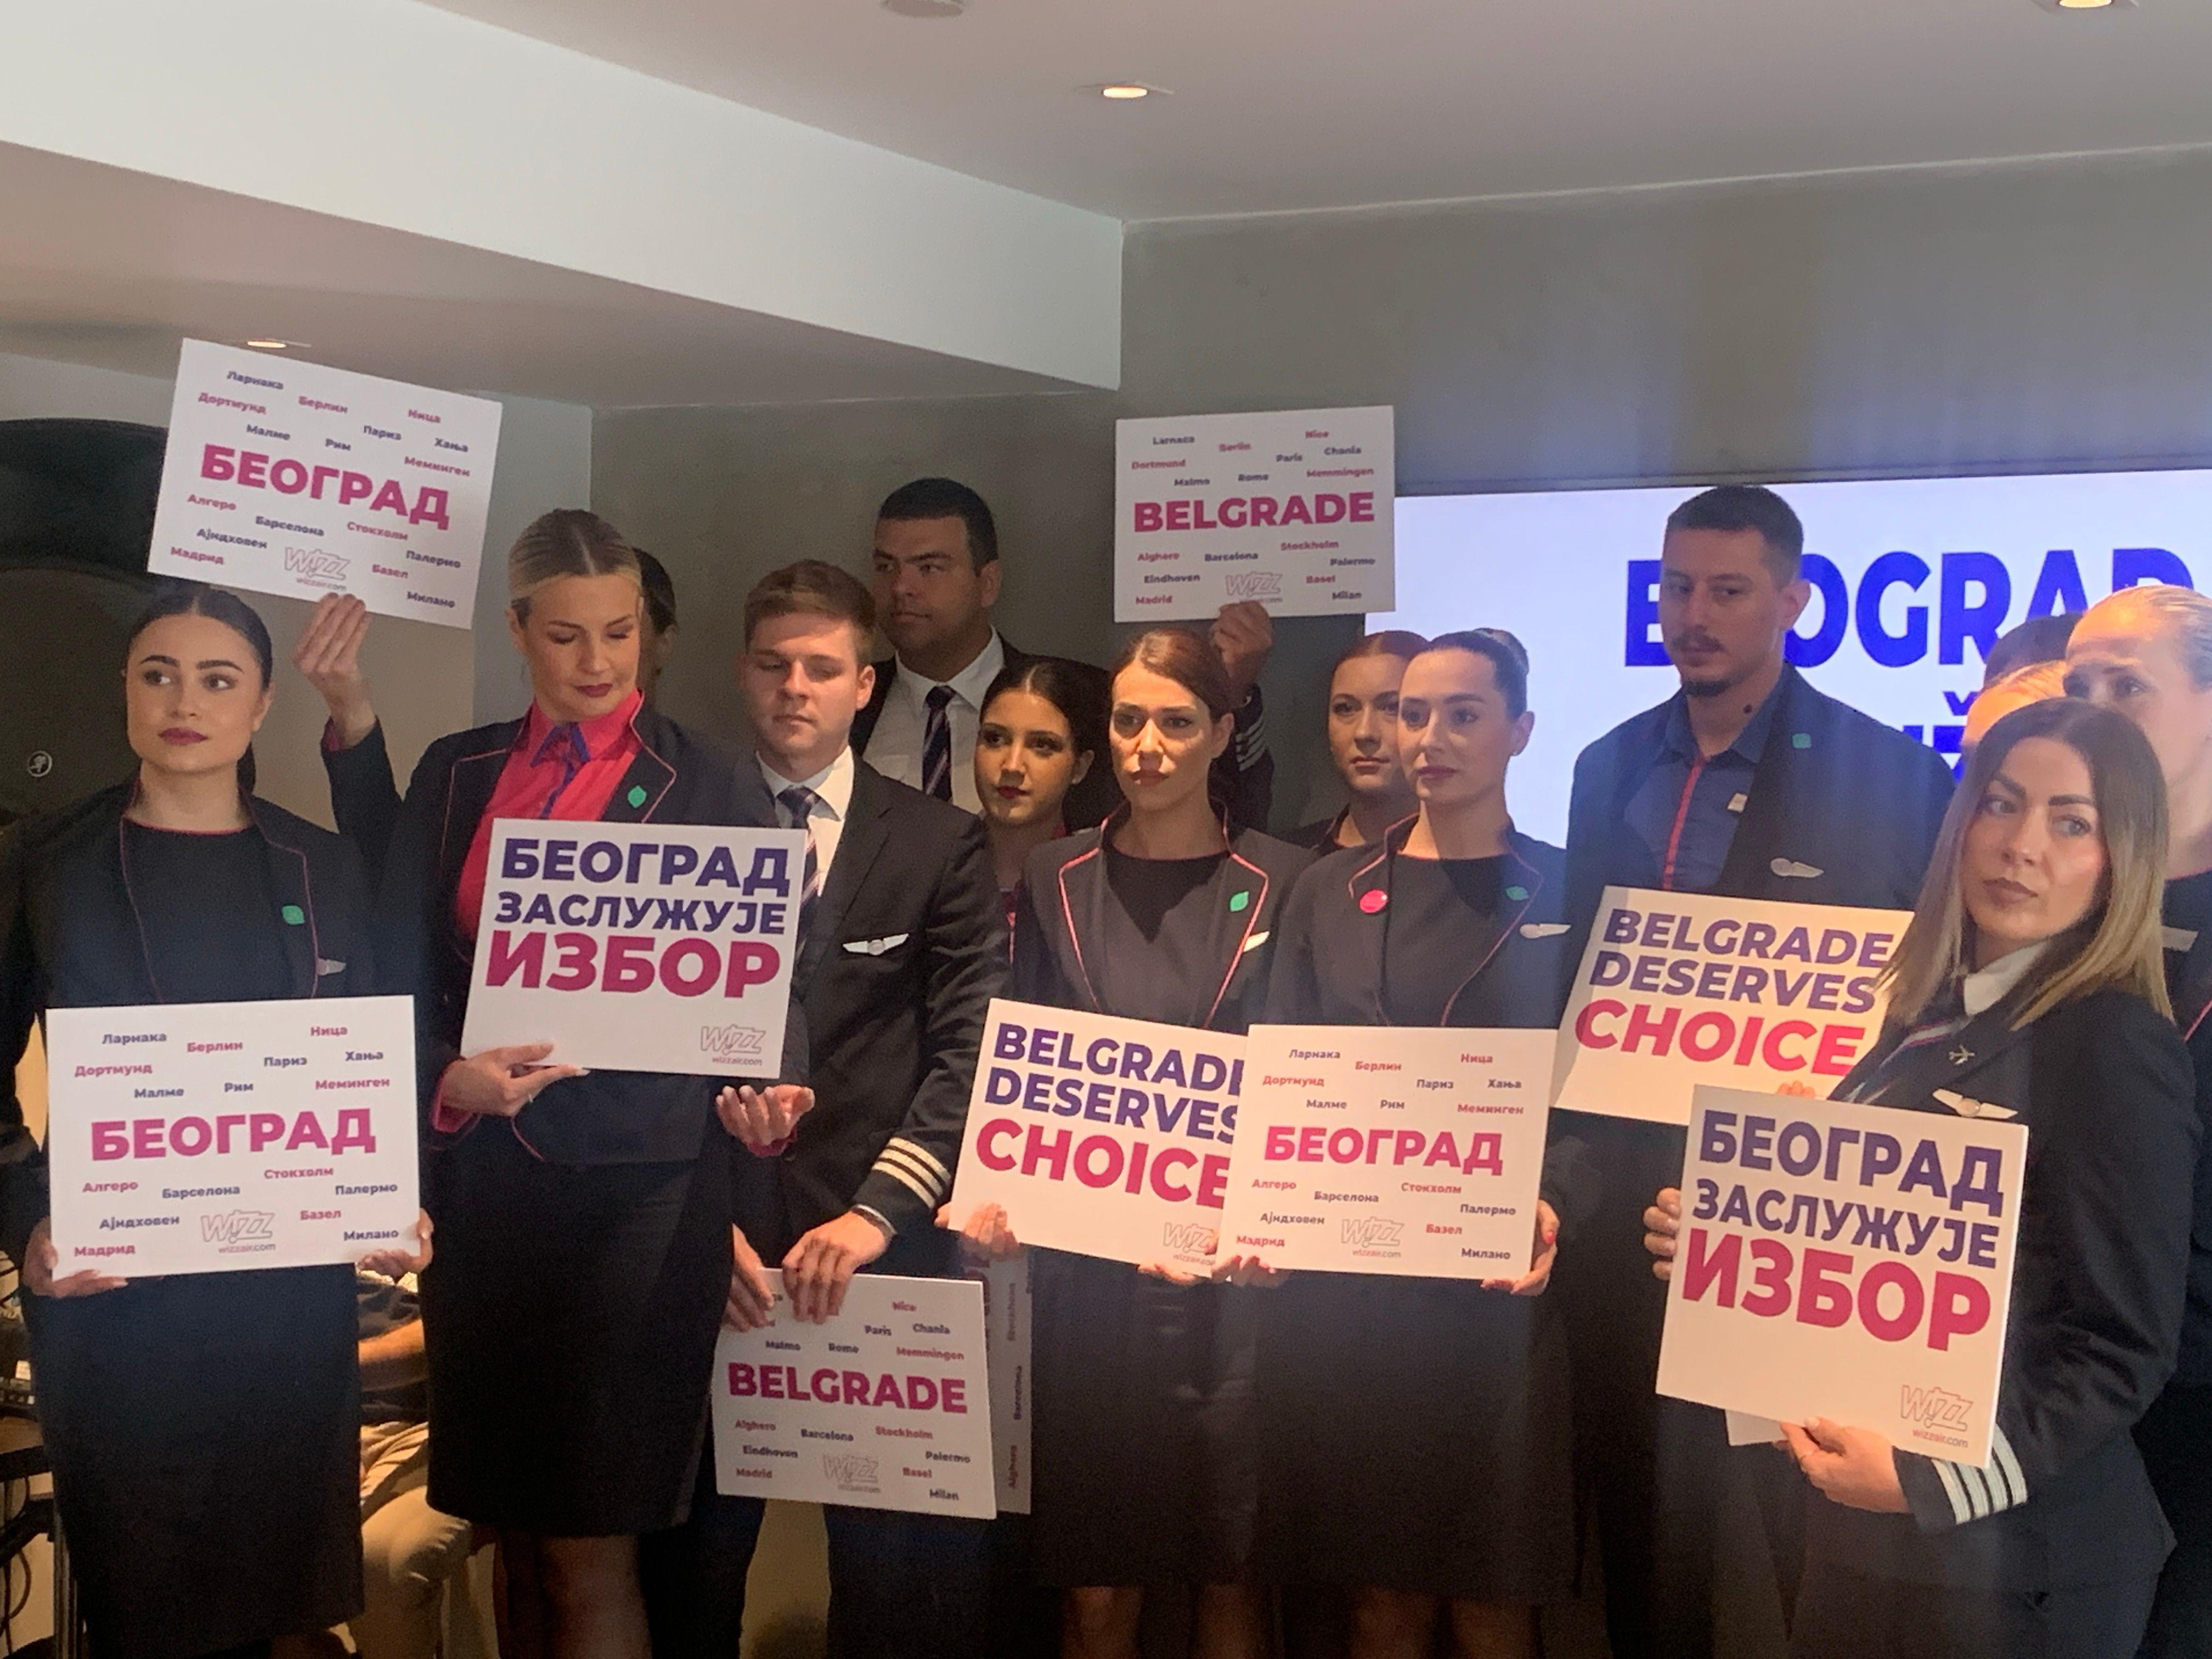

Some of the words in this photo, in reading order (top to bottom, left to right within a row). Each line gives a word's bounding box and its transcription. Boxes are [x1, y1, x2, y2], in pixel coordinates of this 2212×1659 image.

[227, 371, 284, 390] Ларнака
[198, 392, 266, 414] Дортмунд
[298, 396, 348, 413] Берлин
[408, 409, 441, 423] Ница
[246, 425, 290, 441] Малме
[364, 425, 401, 440] Париз
[1305, 430, 1329, 438] Nice
[325, 438, 351, 451] Рим
[435, 438, 468, 452] Хања
[1153, 437, 1195, 445] Larnaca
[1219, 442, 1251, 452] Berlin
[1324, 445, 1362, 455] Chania
[1276, 453, 1302, 462] Paris
[404, 456, 470, 477] Меминген
[1132, 459, 1186, 469] Dortmund
[1306, 468, 1374, 477] Memmingen
[200, 443, 450, 529] БЕОГРАД
[187, 494, 236, 510] Алгеро
[1135, 492, 1374, 532] BELGRADE
[256, 516, 324, 536] Барселона
[347, 522, 409, 541] Стокхолм
[197, 529, 267, 549] Ајндховен
[1281, 540, 1339, 551] Stockholm
[171, 546, 224, 565] Мадрид
[407, 550, 461, 568] Палермо
[1138, 553, 1180, 562] Alghero
[1205, 552, 1259, 562] Barcelona
[372, 565, 409, 579] Базел
[1144, 574, 1200, 583] Eindhoven
[1306, 575, 1335, 584] Basel
[408, 591, 455, 608] Милано
[1136, 595, 1172, 604] Madrid
[1332, 591, 1362, 600] Milan
[501, 838, 791, 898] БЕОГРАД
[494, 891, 787, 935] ЗАСЛУЖУЈЕ
[1602, 908, 1894, 968] BELGRADE
[485, 929, 781, 999] ИЗБОР
[1589, 951, 1876, 1014] DESERVES
[311, 1026, 347, 1036] Ница
[102, 1034, 167, 1045] Ларнака
[1575, 998, 1865, 1077] CHOICE
[187, 1042, 242, 1053] Берлин
[346, 1052, 383, 1061] Хања
[1289, 1049, 1340, 1060] Ларнака
[1460, 1054, 1493, 1064] Ница
[264, 1057, 307, 1068] Париз
[1355, 1061, 1402, 1072] Берлин
[75, 1065, 153, 1077] Дортмунд
[315, 1079, 390, 1090] Меминген
[1262, 1075, 1324, 1087] Дортмунд
[1417, 1079, 1454, 1090] Париз
[1488, 1079, 1521, 1088] Хања
[134, 1088, 184, 1098] Малме
[224, 1083, 253, 1092] Рим
[1307, 1099, 1347, 1109] Малме
[1380, 1099, 1404, 1109] Рим
[1458, 1104, 1523, 1114] Меминген
[92, 1108, 376, 1161] БЕОГРАД
[1265, 1126, 1503, 1176] БЕОГРАД
[976, 1118, 1231, 1210] CHOICE
[1699, 1109, 2005, 1218] БЕОГРАД
[264, 1168, 334, 1179] Стокхолм
[83, 1182, 138, 1193] Алгеро
[335, 1184, 398, 1195] Палермо
[1252, 1179, 1296, 1191] Алгеро
[1401, 1182, 1462, 1193] Стокхолм
[162, 1187, 240, 1200] Барселона
[1314, 1191, 1379, 1203] Барселона
[300, 1210, 341, 1220] Базел
[1460, 1204, 1516, 1216] Палермо
[99, 1216, 179, 1231] Ајндховен
[1260, 1212, 1325, 1224] Ајндховен
[1692, 1178, 2000, 1269] ЗАСЛУЖУЈЕ
[1426, 1224, 1462, 1234] Базел
[344, 1230, 399, 1241] Милано
[1237, 1235, 1285, 1248] Мадрид
[74, 1244, 136, 1257] Мадрид
[218, 1244, 276, 1253] wizzair.com
[1462, 1248, 1510, 1260] Милано
[1682, 1227, 1991, 1352] ИЗБОР
[892, 1301, 917, 1311] Nice
[865, 1325, 891, 1336] Paris
[912, 1323, 950, 1334] Chania
[765, 1340, 800, 1350] Malmo
[828, 1342, 859, 1353] Rome
[896, 1347, 964, 1361] Memmingen
[728, 1362, 968, 1414] BELGRADE
[735, 1419, 776, 1431] Alghero
[801, 1429, 854, 1441] Barcelona
[875, 1426, 933, 1439] Stockholm
[1912, 1427, 1969, 1449] wizzair.com
[742, 1444, 798, 1458] Eindhoven
[926, 1451, 970, 1463] Palermo
[736, 1468, 772, 1478] Madrid
[902, 1467, 932, 1478] Basel
[929, 1489, 959, 1500] Milan
